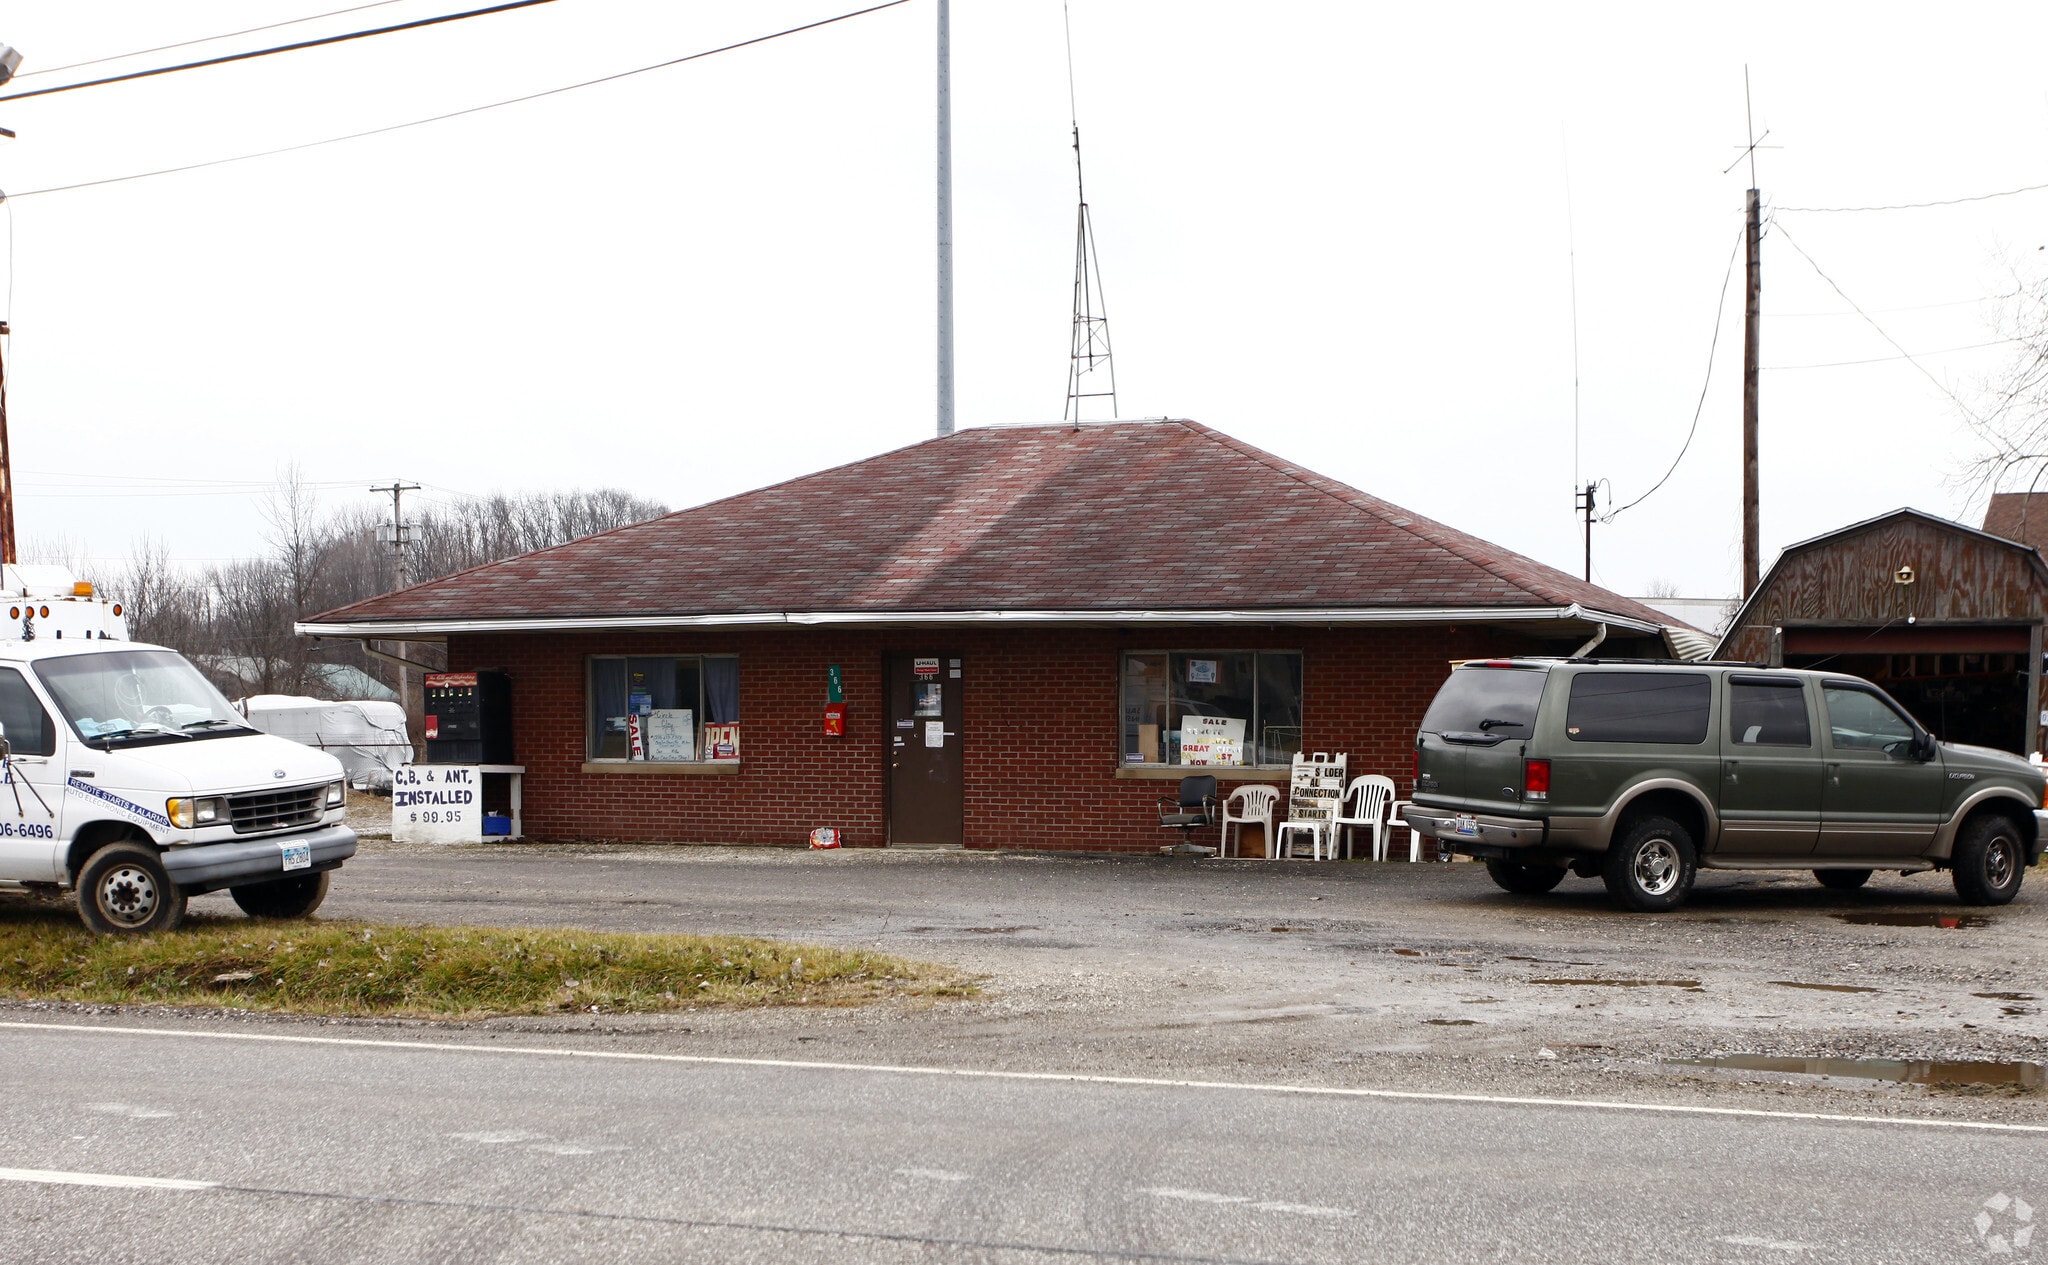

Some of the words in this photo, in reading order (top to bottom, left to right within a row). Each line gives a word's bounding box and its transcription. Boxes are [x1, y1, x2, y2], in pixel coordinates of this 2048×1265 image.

[829, 668, 842, 694] 366
[1202, 718, 1227, 726] SALE
[629, 714, 642, 757] SALE
[1182, 744, 1210, 752] GREAT
[395, 770, 421, 785] C.B.
[426, 770, 435, 782] &
[445, 769, 473, 784] ANT.
[395, 790, 473, 807] INSTALLED
[1294, 786, 1340, 798] CONNECTION
[65, 786, 84, 799] AUTO
[85, 795, 127, 817] ELECTRONIC
[127, 813, 171, 835] EQUIPMENT
[70, 779, 102, 798] REMOTE
[101, 791, 130, 809] STARTS
[130, 803, 137, 812] &
[136, 806, 169, 826] ALARMS
[410, 812, 417, 823] $
[422, 811, 462, 823] 99.95
[1298, 809, 1327, 819] STARTS
[0, 822, 53, 839] 06-6496
